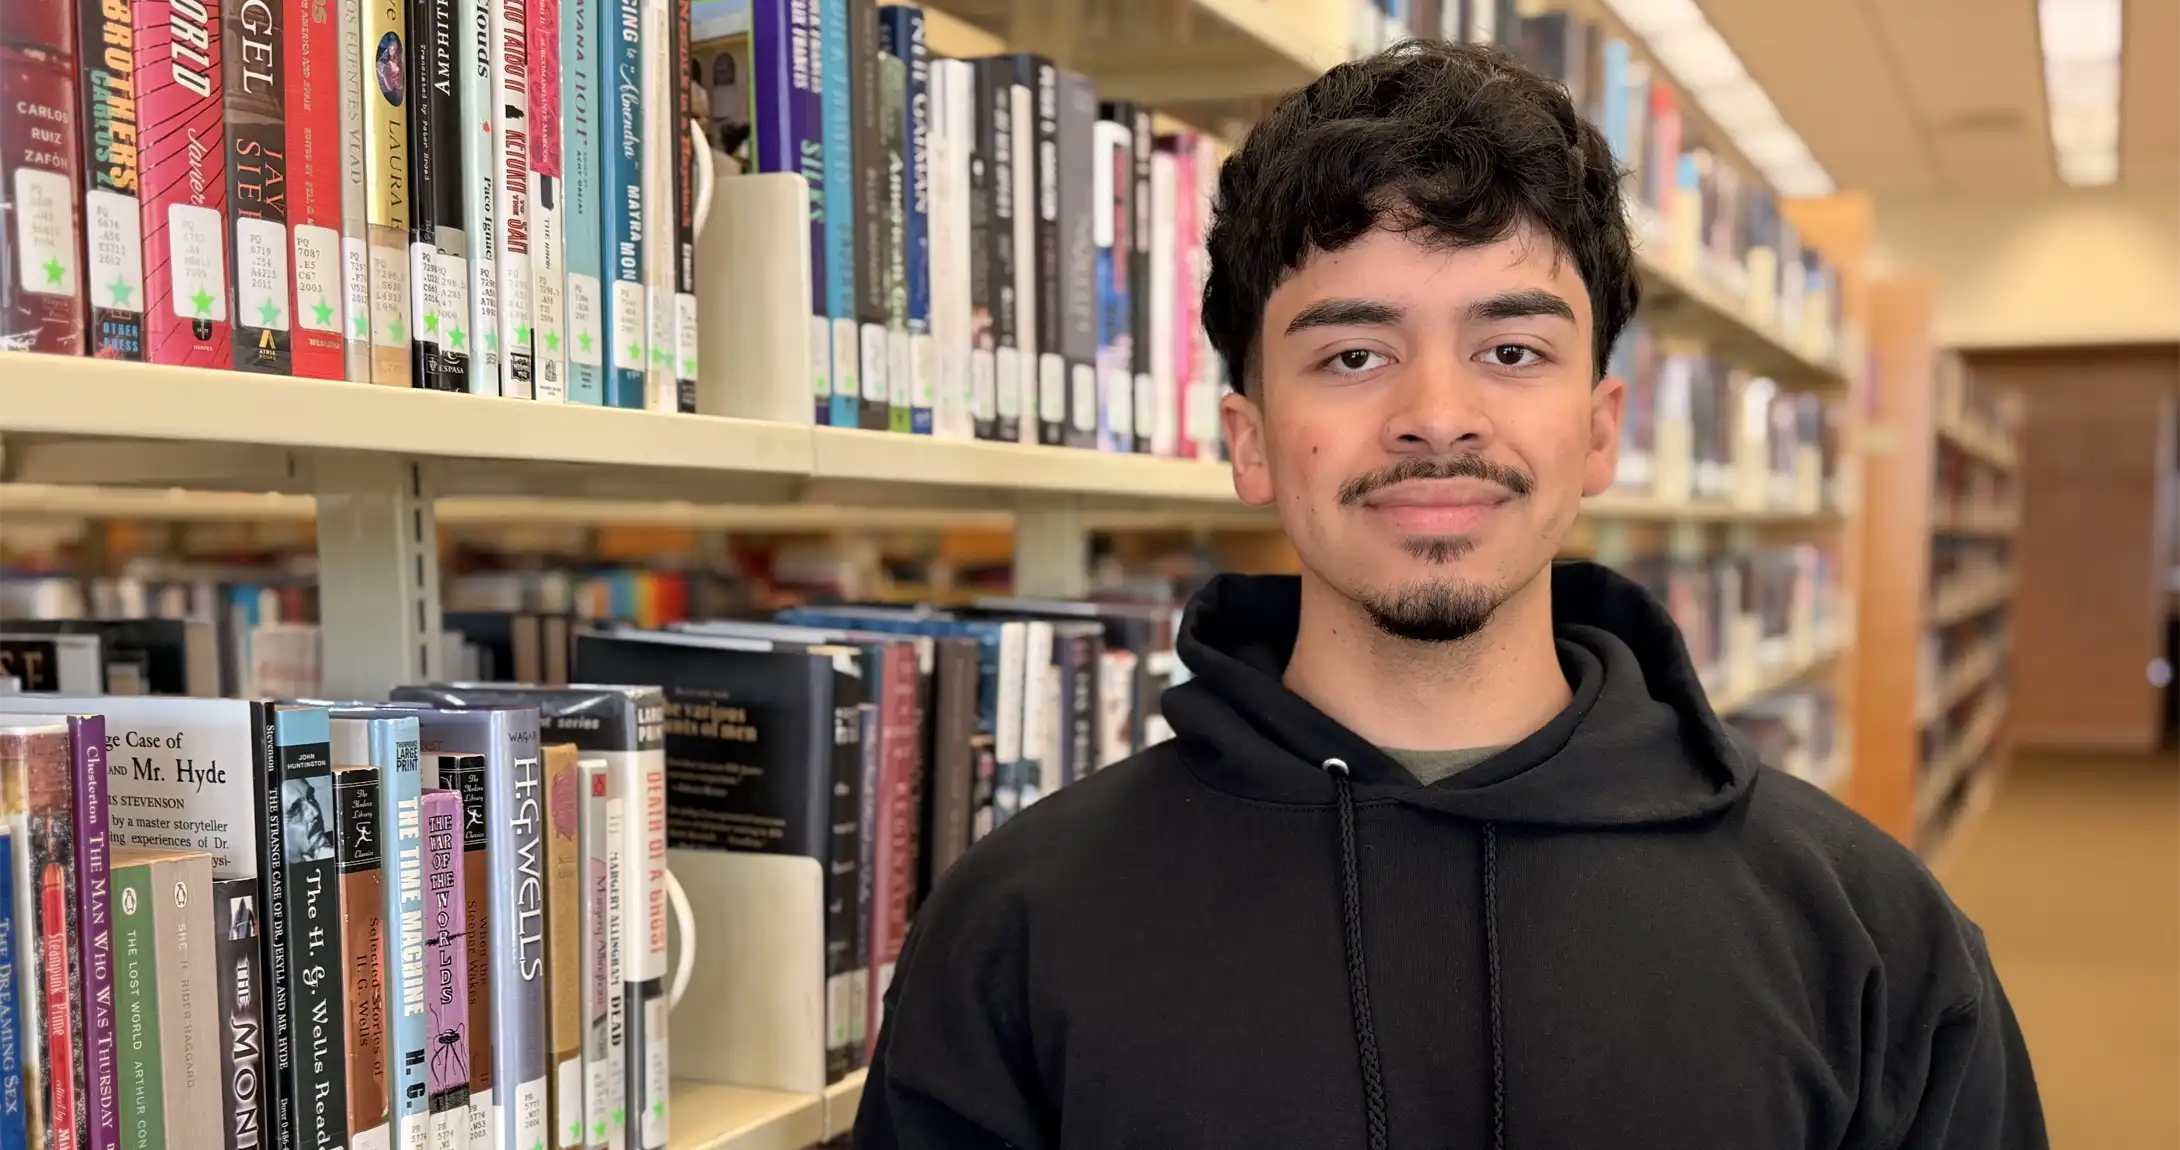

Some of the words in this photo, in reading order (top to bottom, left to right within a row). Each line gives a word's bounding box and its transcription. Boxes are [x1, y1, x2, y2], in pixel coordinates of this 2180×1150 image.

[344, 31, 360, 122] FUENTES
[420, 44, 429, 101] Translated
[17, 102, 69, 124] CARLOS
[91, 70, 114, 162] CARLOS
[102, 0, 138, 195] BROTHERS
[619, 63, 641, 160] Almendra
[31, 127, 62, 145] RUIZ
[188, 128, 207, 206] Javier
[264, 148, 286, 215] JAV
[388, 119, 403, 208] LAURA
[484, 176, 493, 212] Paco
[626, 184, 642, 242] MAYRA
[297, 237, 309, 247] PQ
[299, 249, 321, 258] 7087
[102, 321, 139, 338] OTHER
[126, 731, 161, 748] Case
[166, 731, 184, 749] of
[557, 716, 600, 730] series
[266, 723, 277, 773] Stevenson
[286, 759, 327, 770] HUNTINGTON
[297, 752, 316, 761] JOHN
[395, 747, 419, 760] LARGE
[396, 759, 419, 773] PRINT
[85, 745, 101, 824] Chesterton
[108, 765, 128, 775] AND
[131, 757, 165, 782] Mr.
[175, 759, 226, 793] Hyde
[120, 796, 185, 809] STEVENSON
[267, 787, 280, 814] THE
[398, 796, 420, 840] THE
[646, 771, 664, 832] DEATH
[112, 814, 125, 829] by
[127, 817, 134, 827] a
[136, 816, 171, 829] master
[173, 819, 228, 835] storyteller
[131, 832, 192, 848] experiences
[197, 835, 208, 849] of
[214, 836, 229, 850] Dr.
[268, 814, 282, 869] STRANGE
[429, 814, 453, 833] THE
[429, 833, 453, 852] WAR
[89, 831, 105, 873] THE
[431, 852, 451, 870] OF
[648, 839, 664, 860] OF
[270, 870, 283, 901] CASE
[306, 868, 322, 920] The
[400, 845, 422, 904] TIME
[430, 871, 455, 891] THE
[610, 851, 622, 911] MARGERY
[649, 869, 663, 882] A
[91, 879, 106, 924] MAN
[272, 902, 284, 919] OF
[516, 834, 544, 981] WELLS
[593, 876, 607, 935] Margery
[649, 889, 665, 954] GHOST
[125, 929, 139, 957] THE
[176, 922, 189, 950] SHE
[273, 920, 285, 941] DR.
[308, 925, 326, 957] H.
[434, 890, 454, 1004] WORLDS
[467, 899, 478, 954] Sleeper
[478, 916, 489, 956] When
[46, 931, 66, 995] Steampunk
[94, 929, 109, 980] WHO
[273, 943, 287, 985] JEKYLL
[356, 953, 368, 973] H.
[368, 917, 382, 987] Selected
[401, 910, 426, 1017] MACHINE
[610, 914, 622, 987] ALLINGHAM
[127, 961, 141, 996] LOST
[237, 963, 252, 1004] THE
[302, 964, 327, 995] G.
[357, 978, 370, 996] G.
[469, 959, 480, 1005] Wakes
[478, 959, 489, 985] the
[596, 939, 608, 1005] Allingham
[0, 962, 15, 1070] DREAMING
[51, 1001, 67, 1036] Prime
[96, 984, 111, 1029] WAS
[181, 979, 194, 1020] RIDER
[276, 986, 288, 1011] AND
[129, 1000, 143, 1050] WORLD
[277, 1013, 288, 1036] MR.
[311, 996, 329, 1074] Wells
[358, 999, 371, 1047] Wells
[370, 993, 384, 1054] Stories
[610, 995, 623, 1047] DEAD
[182, 1024, 197, 1090] HAGGARD
[278, 1038, 290, 1070] HYDE
[374, 1060, 385, 1077] of
[405, 1047, 426, 1076] H.
[4, 1074, 20, 1115] SEX
[97, 1031, 113, 1129] THURSDAY
[133, 1060, 147, 1116] ARTHUR
[406, 1081, 426, 1109] G.
[279, 1097, 289, 1121] Dover
